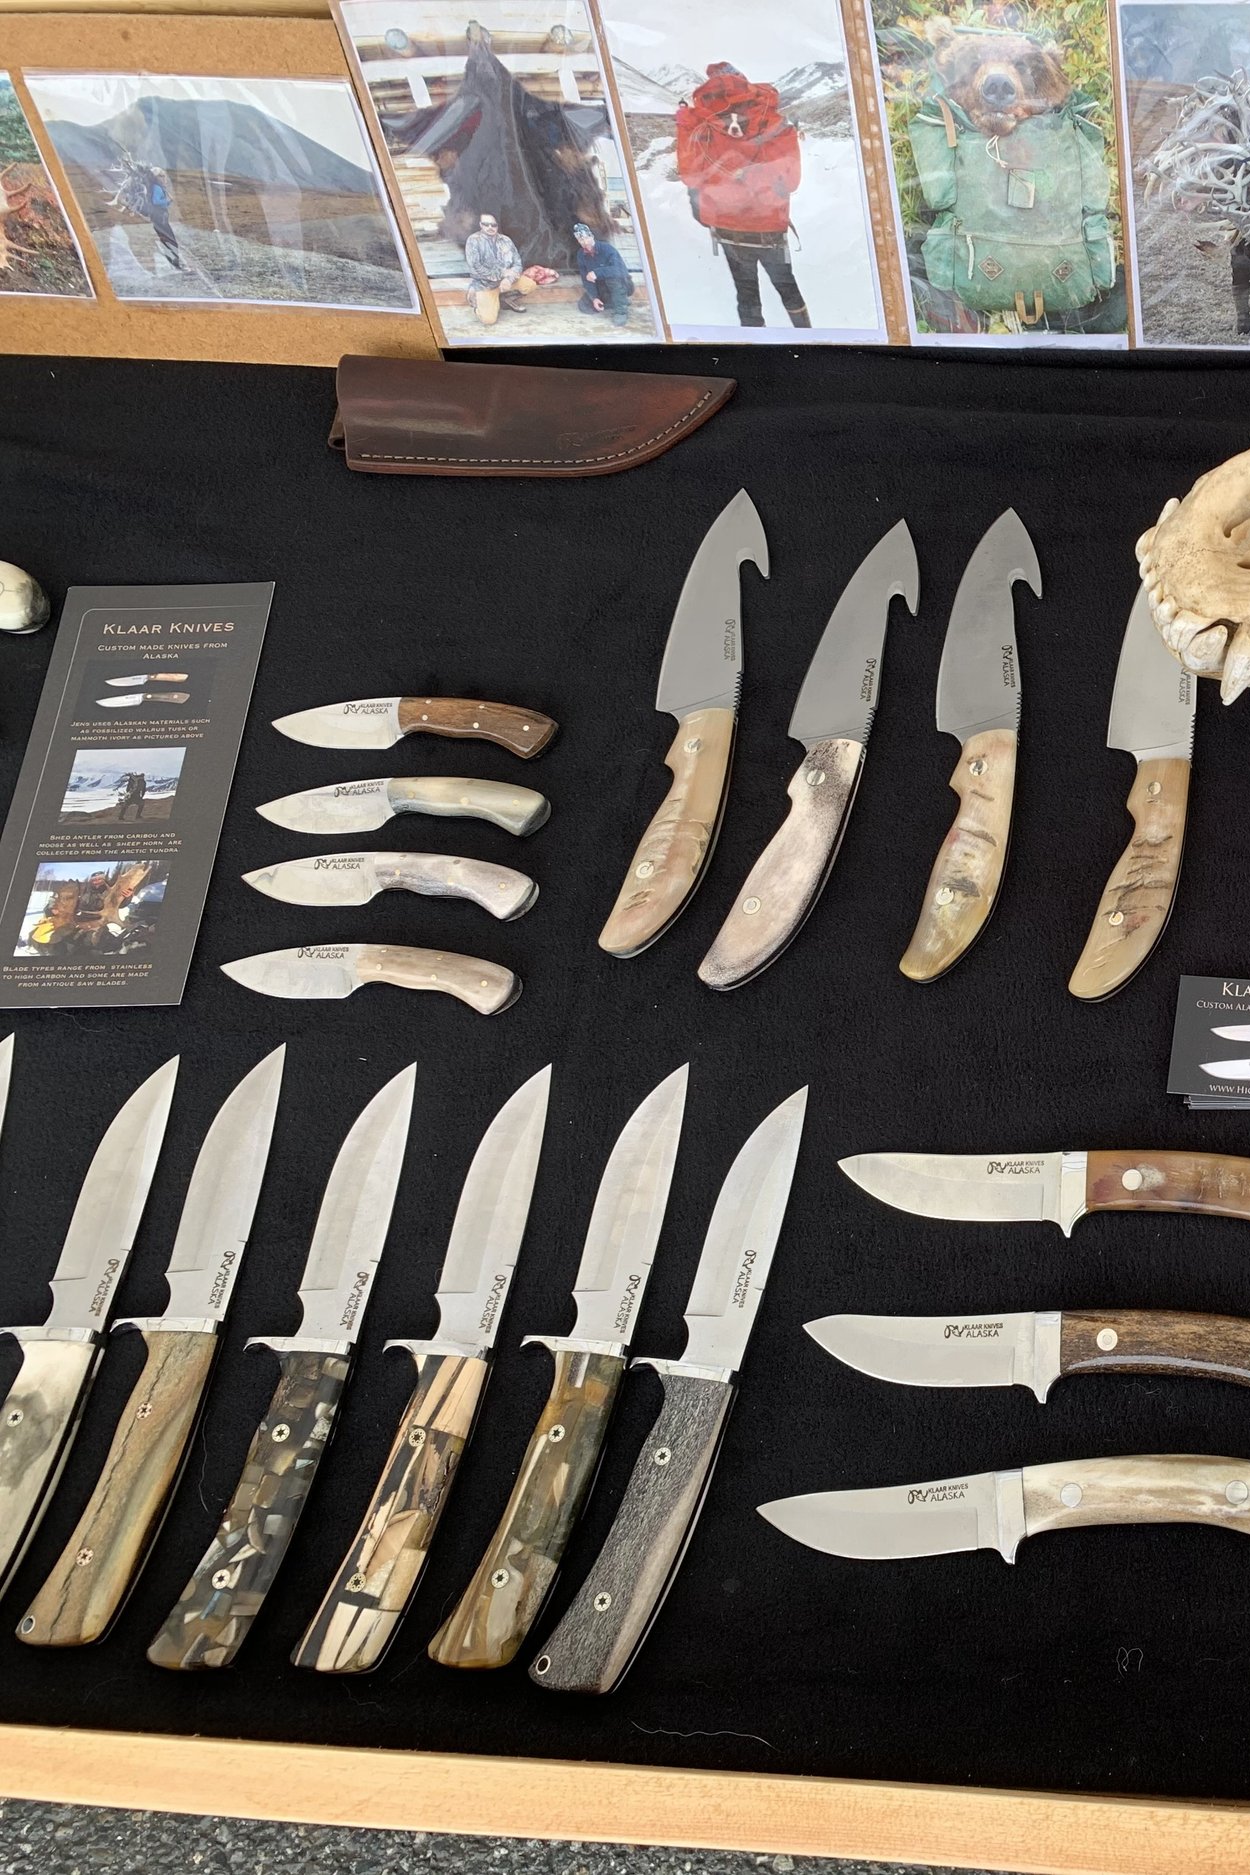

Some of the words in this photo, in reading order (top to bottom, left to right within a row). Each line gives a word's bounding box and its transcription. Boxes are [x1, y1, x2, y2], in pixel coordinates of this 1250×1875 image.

[103, 624, 162, 634] KLAAR
[170, 623, 234, 634] KNIVES
[1196, 1000, 1234, 1010] CUSTOM
[732, 1271, 746, 1304] ALASKA
[966, 1330, 999, 1338] ALASKA
[930, 1491, 965, 1502] ALASKA
